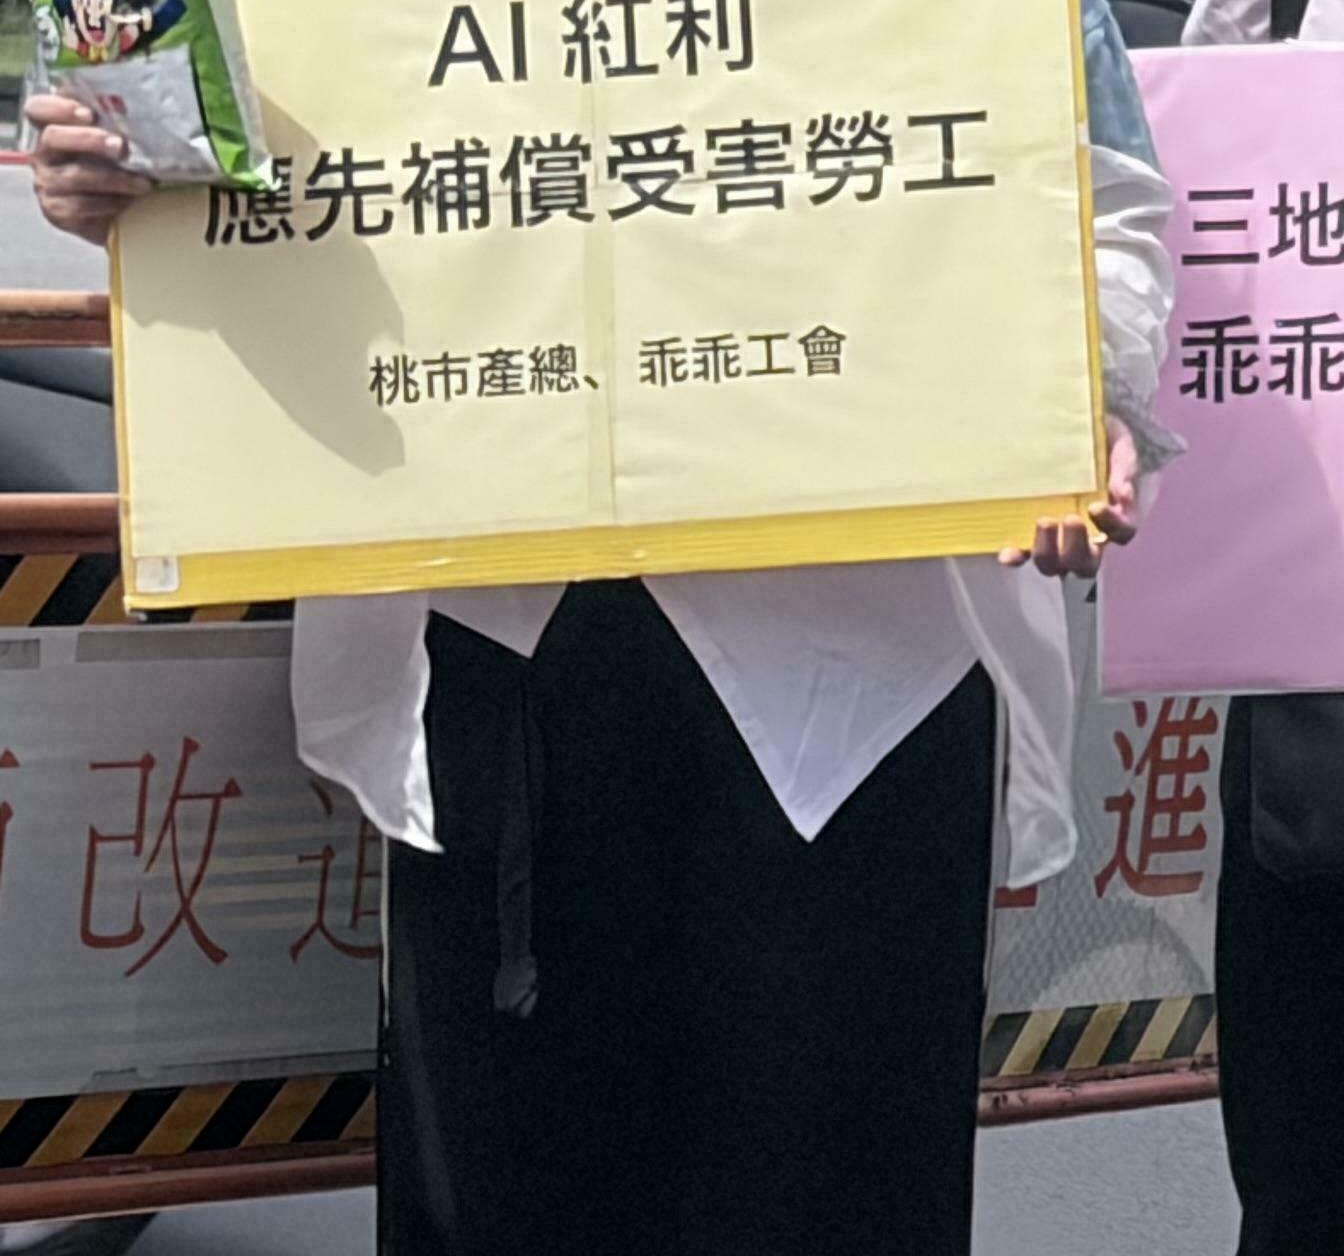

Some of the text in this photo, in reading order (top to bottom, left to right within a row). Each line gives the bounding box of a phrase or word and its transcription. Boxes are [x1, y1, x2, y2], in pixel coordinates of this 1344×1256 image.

[428, 1, 528, 87] AI
[201, 109, 998, 250] 應先補償受害勞工
[367, 323, 850, 409] 桃市產總、乖乖工會
